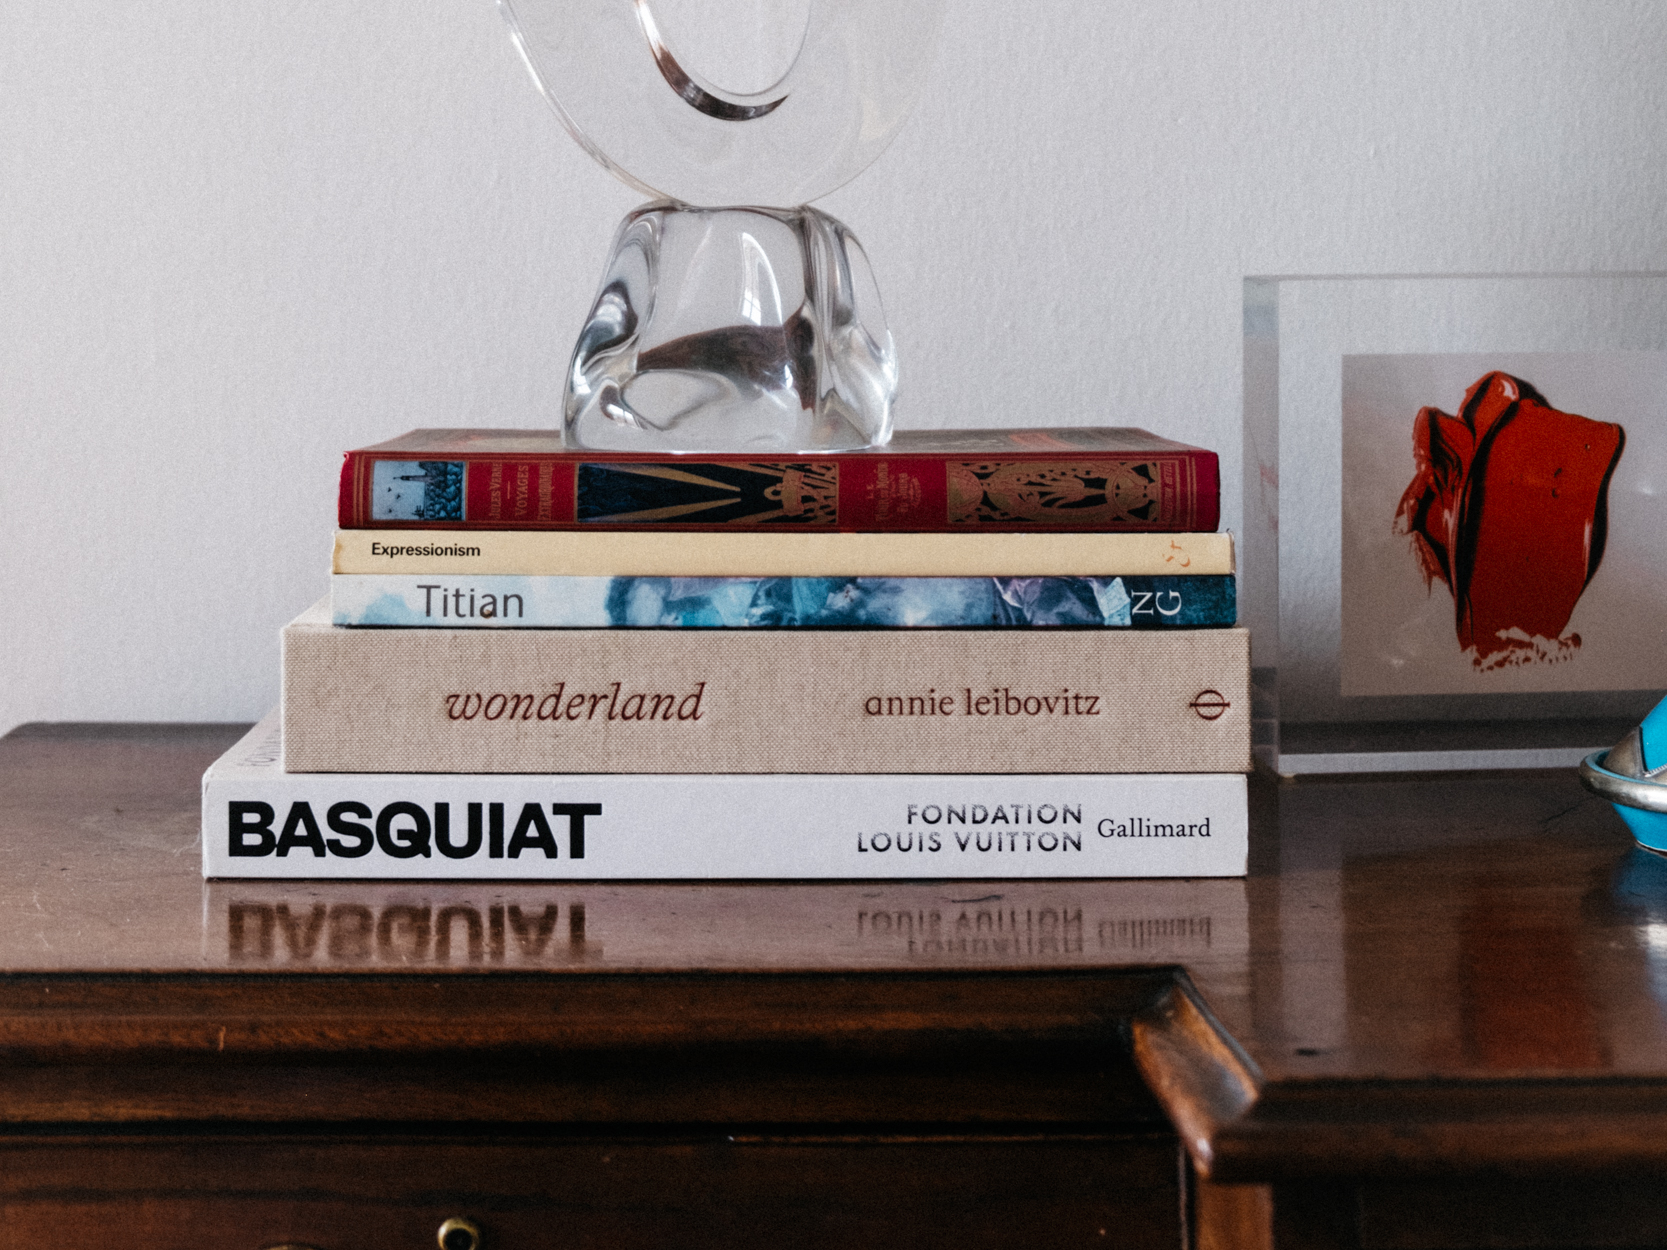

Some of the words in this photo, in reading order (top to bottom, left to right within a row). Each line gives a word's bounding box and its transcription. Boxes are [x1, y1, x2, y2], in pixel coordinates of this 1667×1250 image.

[488, 463, 502, 490] VERNE
[515, 465, 529, 516] VOYAGES
[489, 491, 501, 519] JULES
[371, 541, 481, 559] Expressionism
[417, 584, 524, 619] Titian
[445, 681, 706, 721] wonderland
[864, 688, 954, 716] annie
[965, 688, 1100, 716] leibovitz
[907, 804, 1082, 825] FONDATION
[1097, 817, 1211, 839] Gallimard
[228, 801, 602, 859] BASQUIAT
[857, 832, 942, 853] LOUIS
[955, 832, 1082, 853] VUITTON
